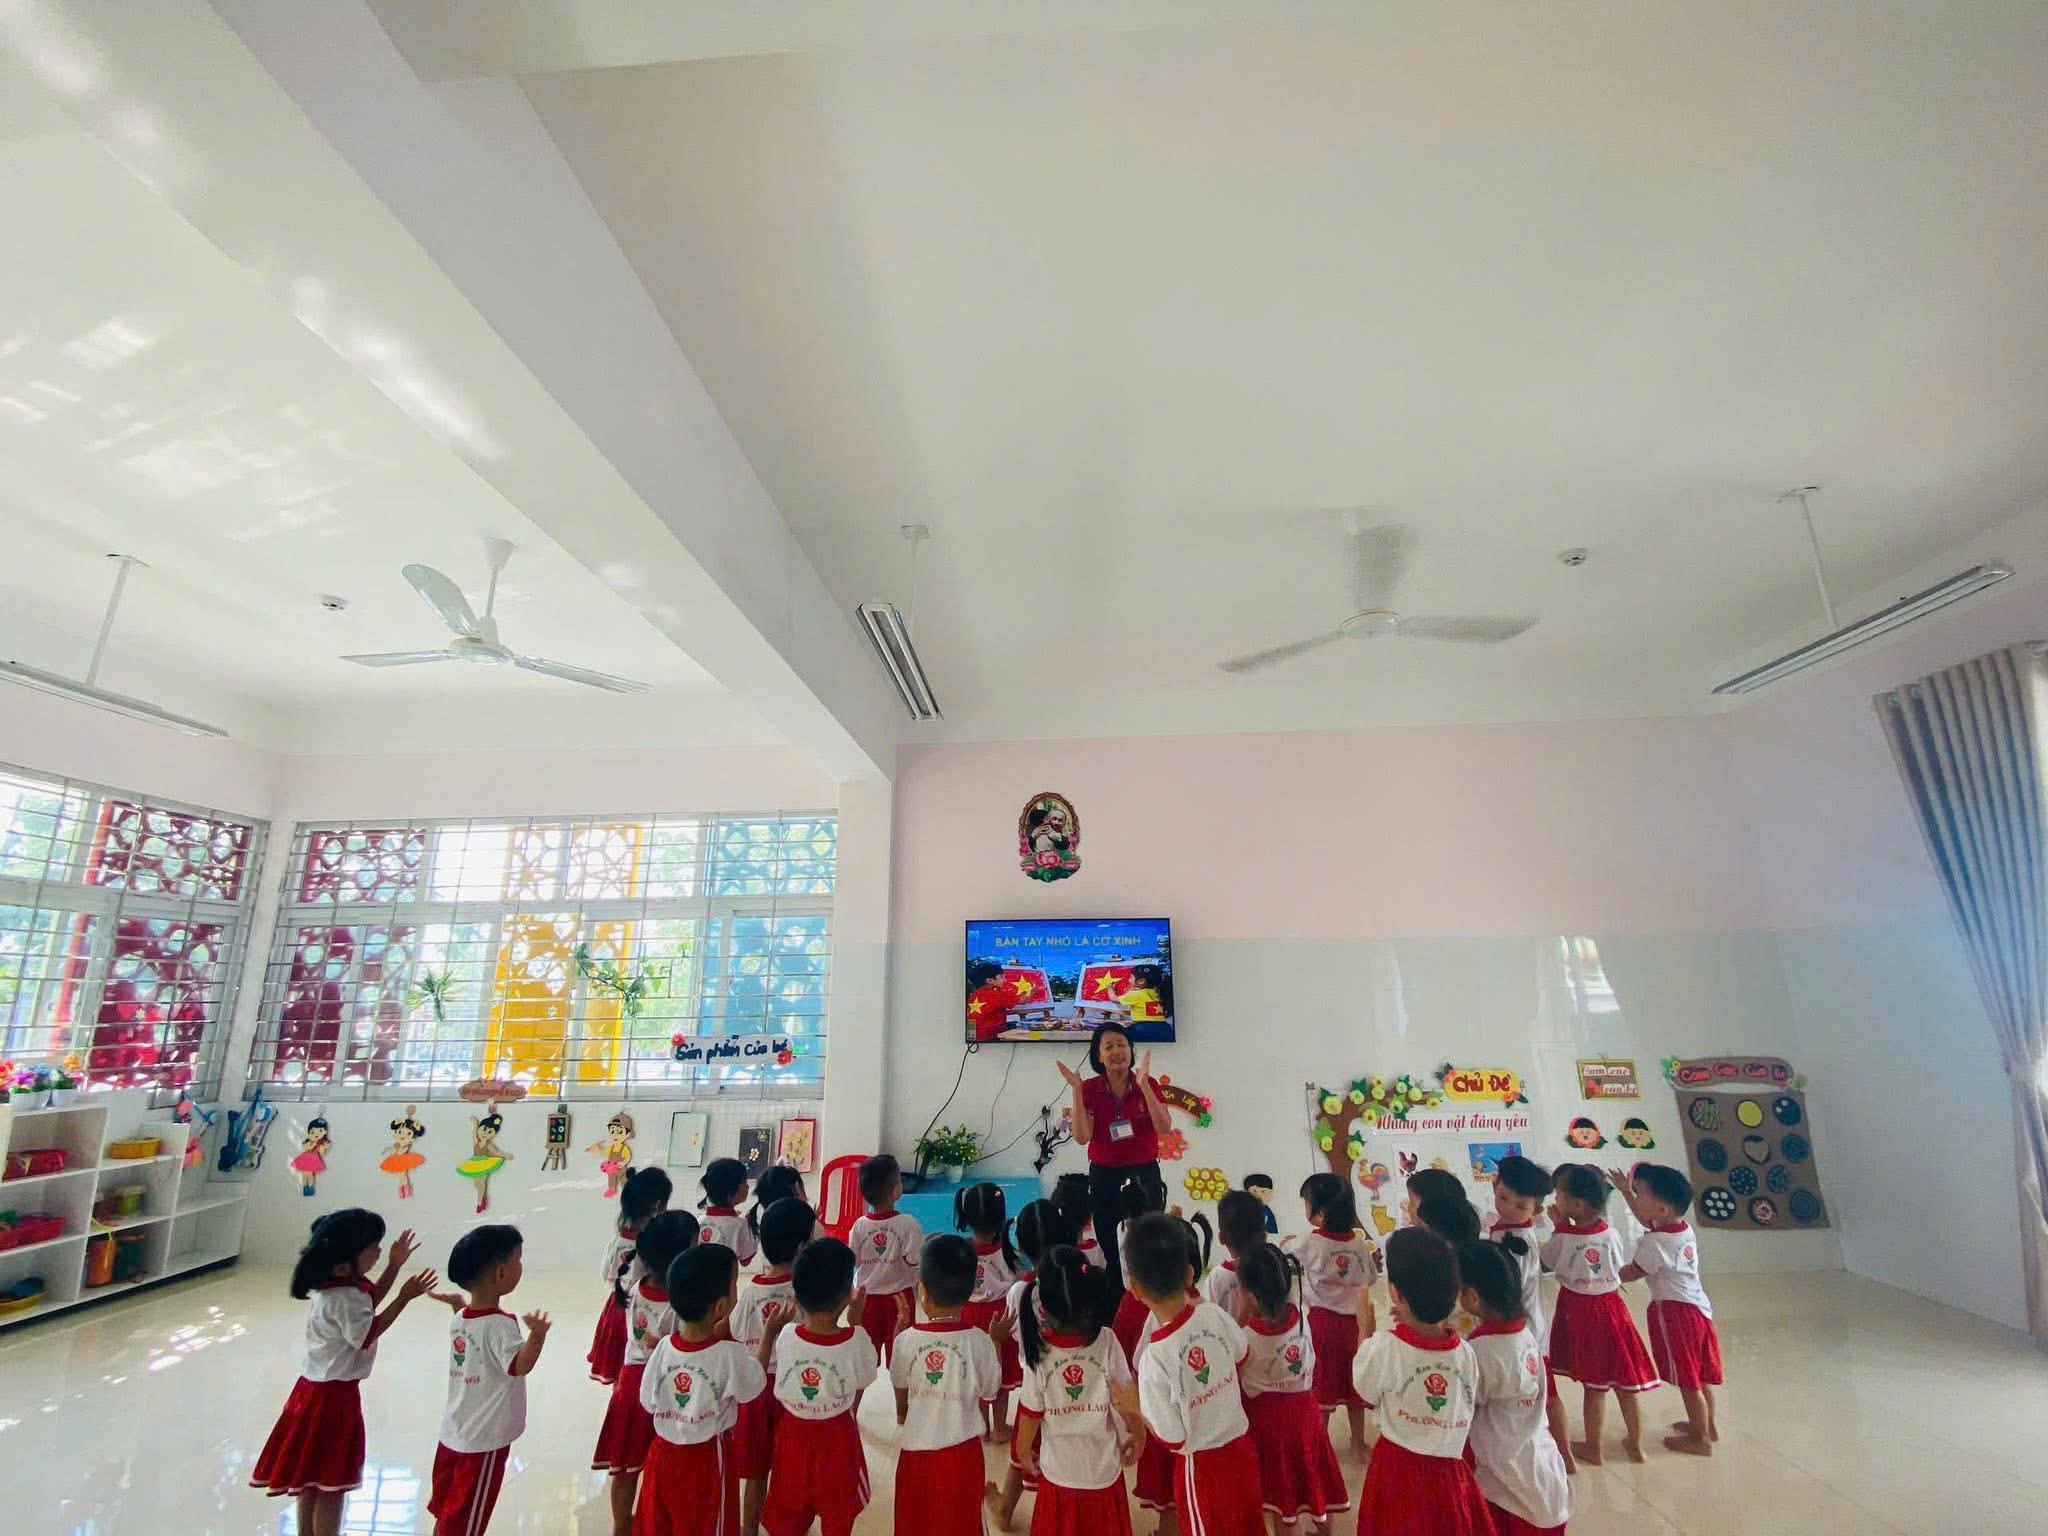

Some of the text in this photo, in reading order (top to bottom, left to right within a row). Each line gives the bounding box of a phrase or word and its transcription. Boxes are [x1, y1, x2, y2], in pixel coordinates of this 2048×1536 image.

[995, 936, 1019, 947] BÀN
[1023, 937, 1044, 947] TAY
[1115, 936, 1142, 946] XINH
[1422, 1119, 1442, 1129] con
[1446, 1114, 1466, 1132] vật
[1470, 1113, 1501, 1131] đáng
[1506, 1113, 1528, 1131] yêu
